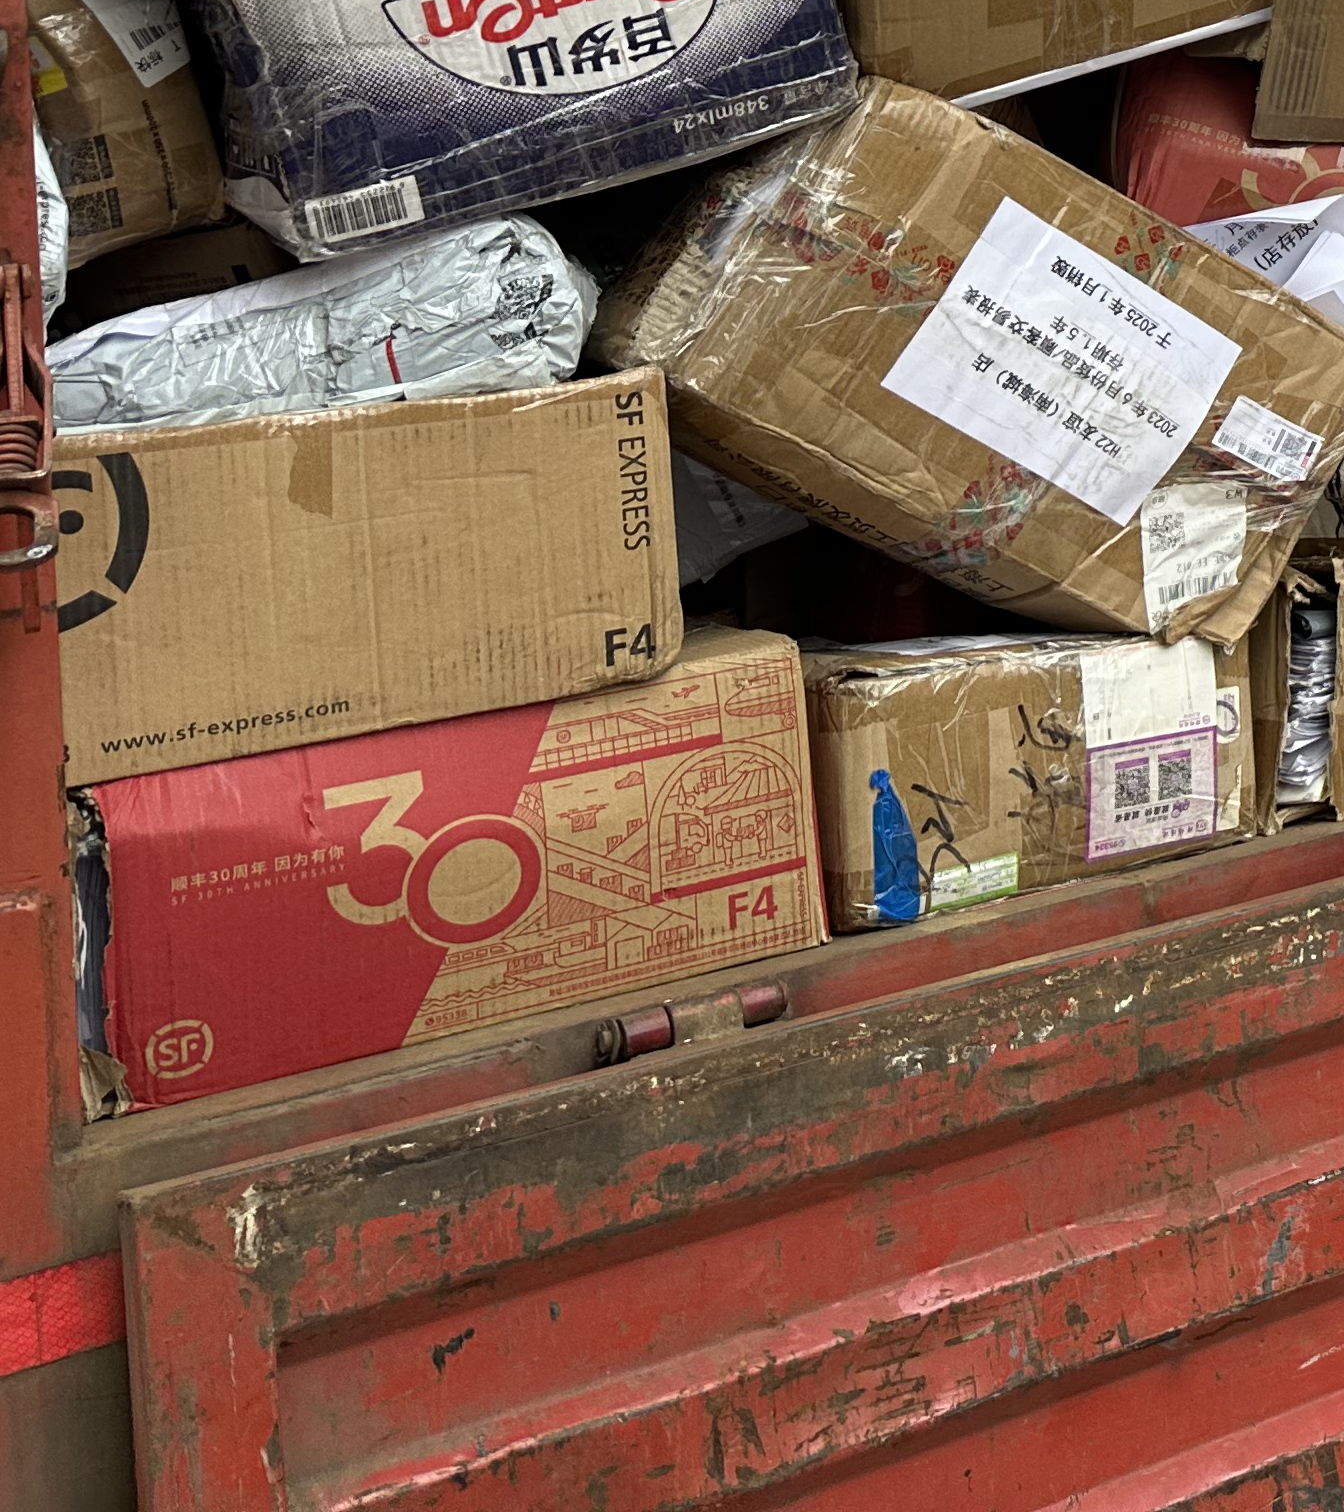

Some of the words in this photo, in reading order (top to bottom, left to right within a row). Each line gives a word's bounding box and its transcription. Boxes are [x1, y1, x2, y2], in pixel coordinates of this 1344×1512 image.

[506, 7, 678, 88] 百岁山
[614, 390, 645, 423] SF
[615, 428, 651, 552] EXPRESS
[604, 623, 658, 669] F4
[100, 696, 353, 756] www.sf-express.com
[170, 858, 269, 894] 顺丰30周年
[272, 843, 347, 873] 因为有你
[728, 883, 778, 931] F4
